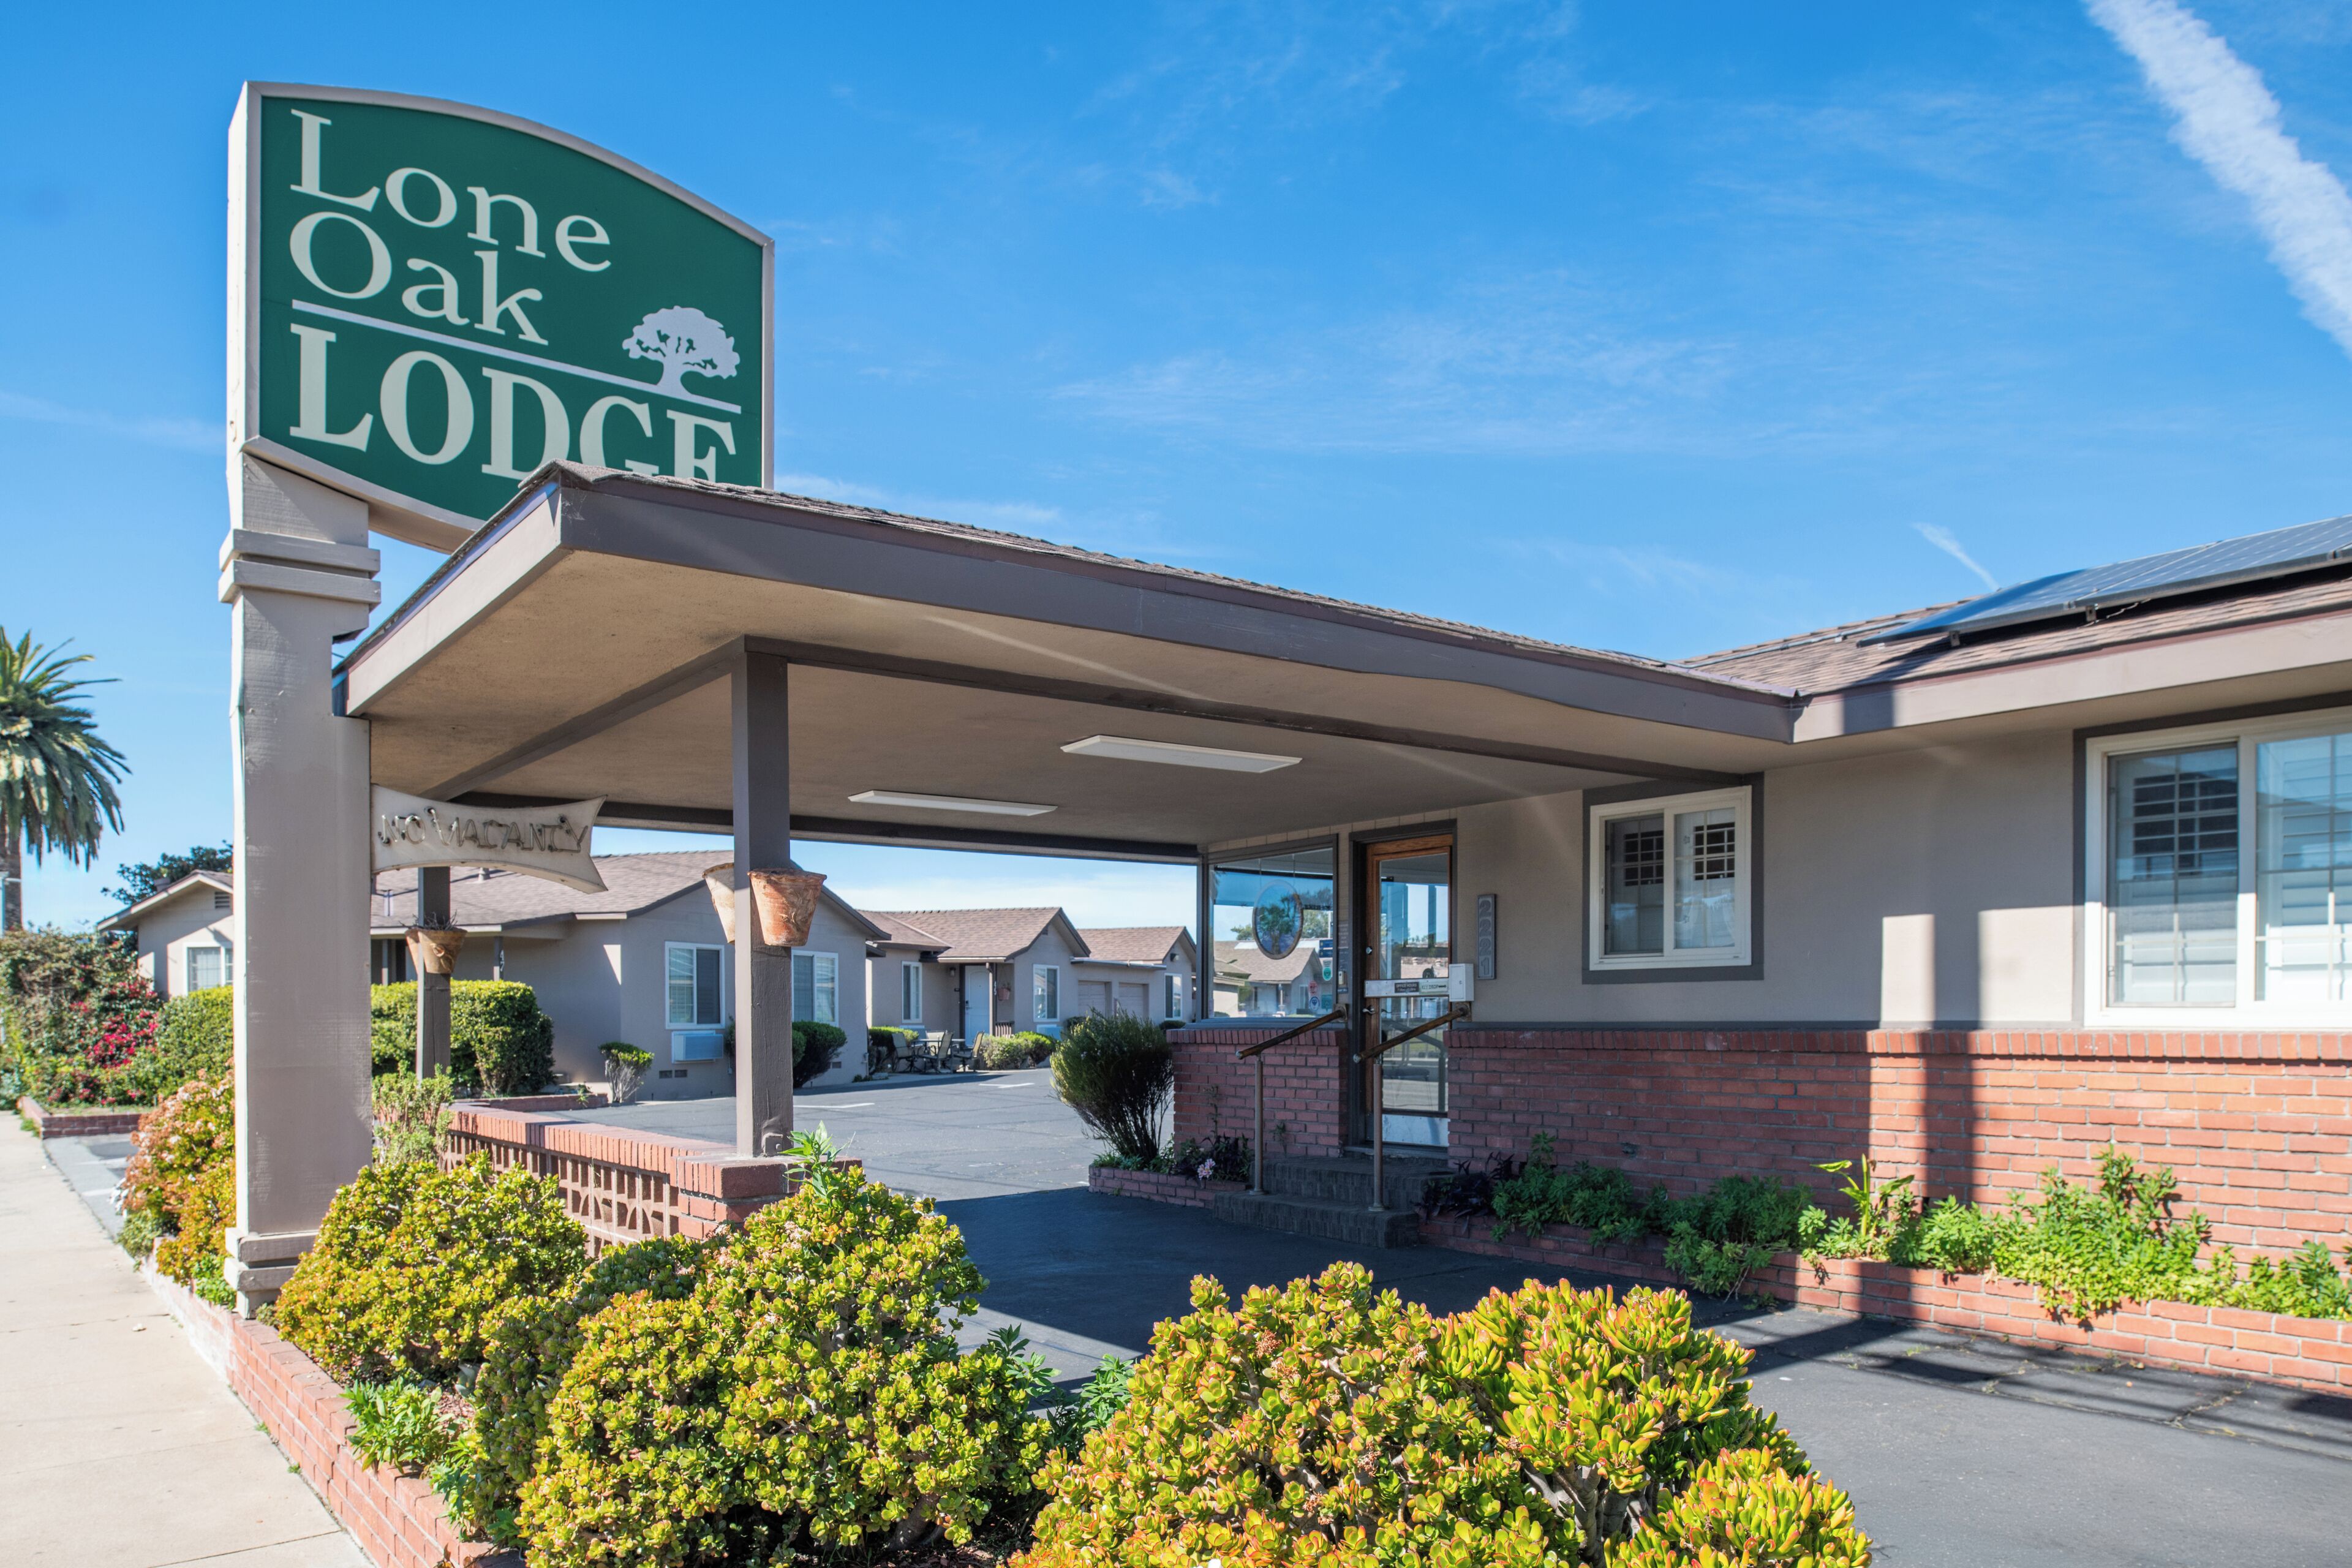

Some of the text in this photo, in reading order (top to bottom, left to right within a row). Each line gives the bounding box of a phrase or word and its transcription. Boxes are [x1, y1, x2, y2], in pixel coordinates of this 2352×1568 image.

[290, 108, 611, 271] Lone
[288, 211, 548, 345] Oak
[289, 323, 736, 483] LODGE
[379, 807, 589, 853] NO VACANCY
[1479, 900, 1491, 976] 2221
